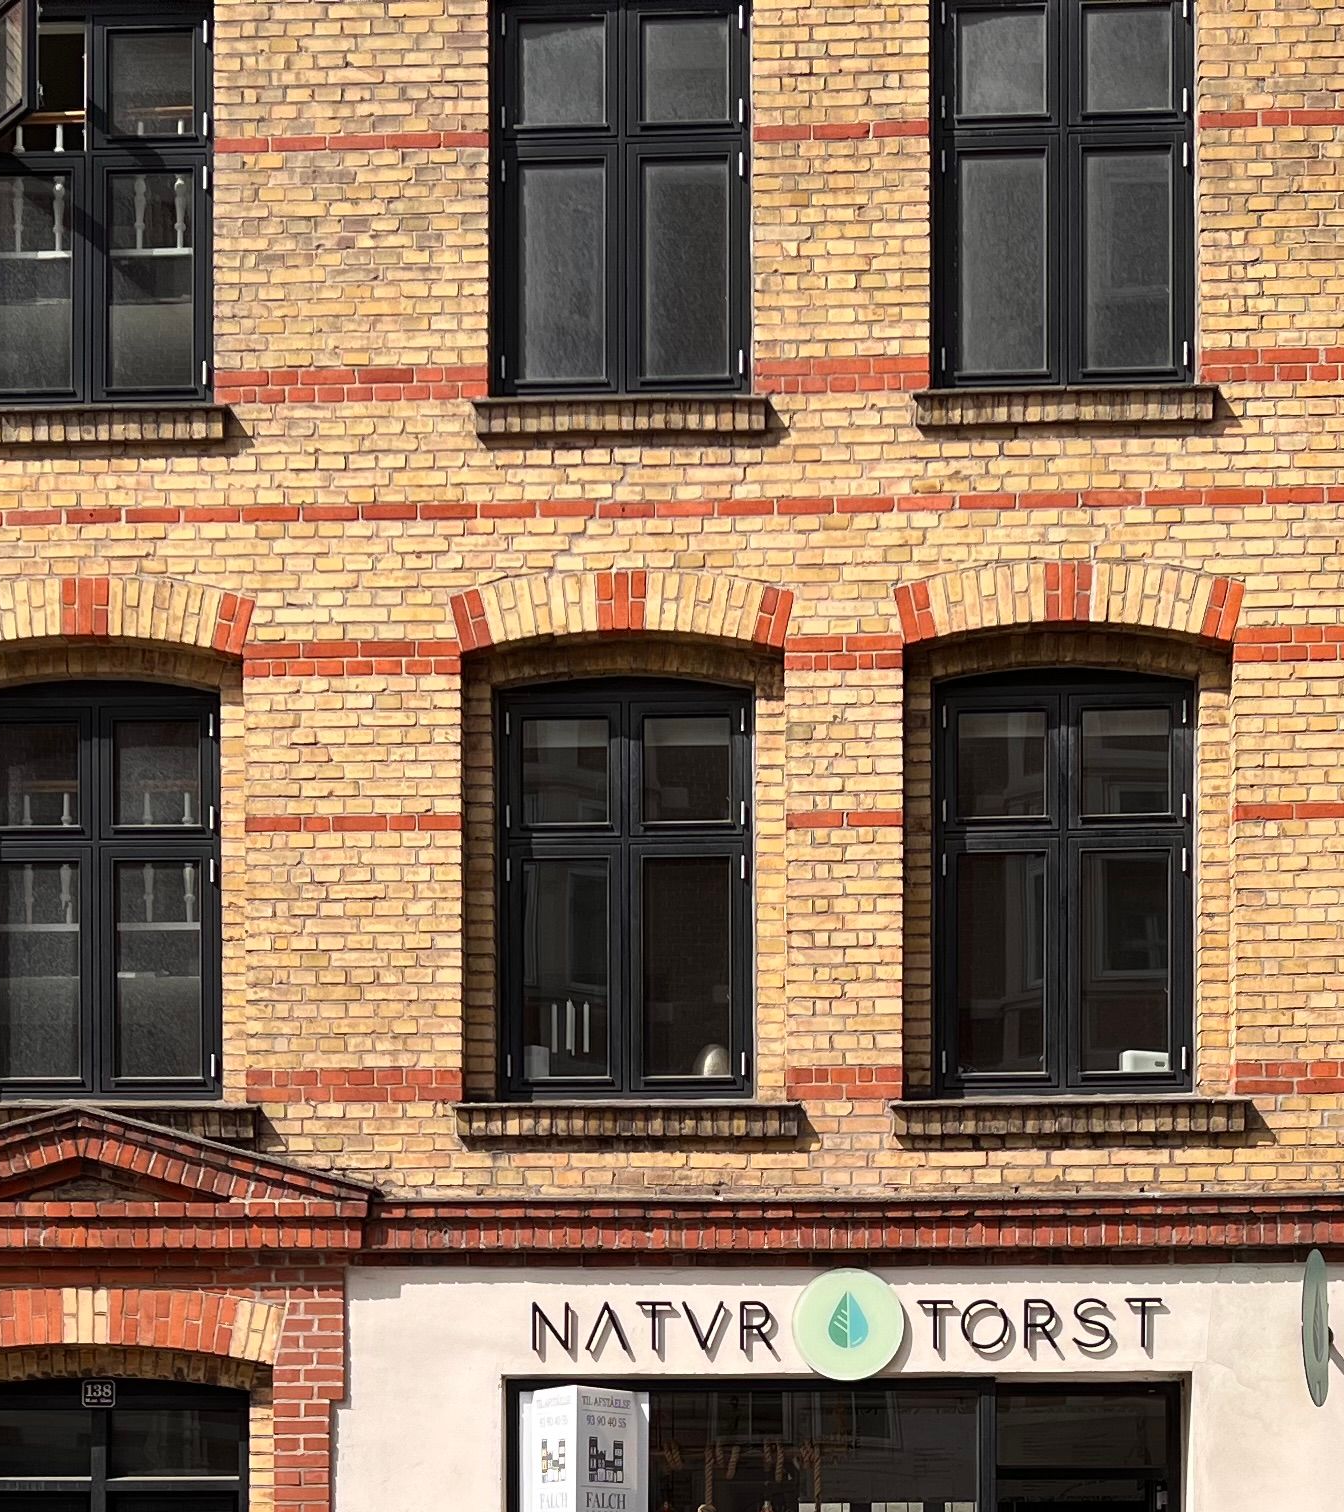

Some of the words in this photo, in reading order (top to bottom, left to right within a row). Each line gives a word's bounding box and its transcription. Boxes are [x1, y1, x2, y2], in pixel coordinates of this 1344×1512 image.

[917, 1297, 1163, 1350] TORST
[85, 1384, 112, 1397] 138
[586, 1414, 595, 1425] 93
[597, 1415, 606, 1426] 90
[608, 1417, 617, 1428] 40
[585, 1491, 626, 1510] FALCH
